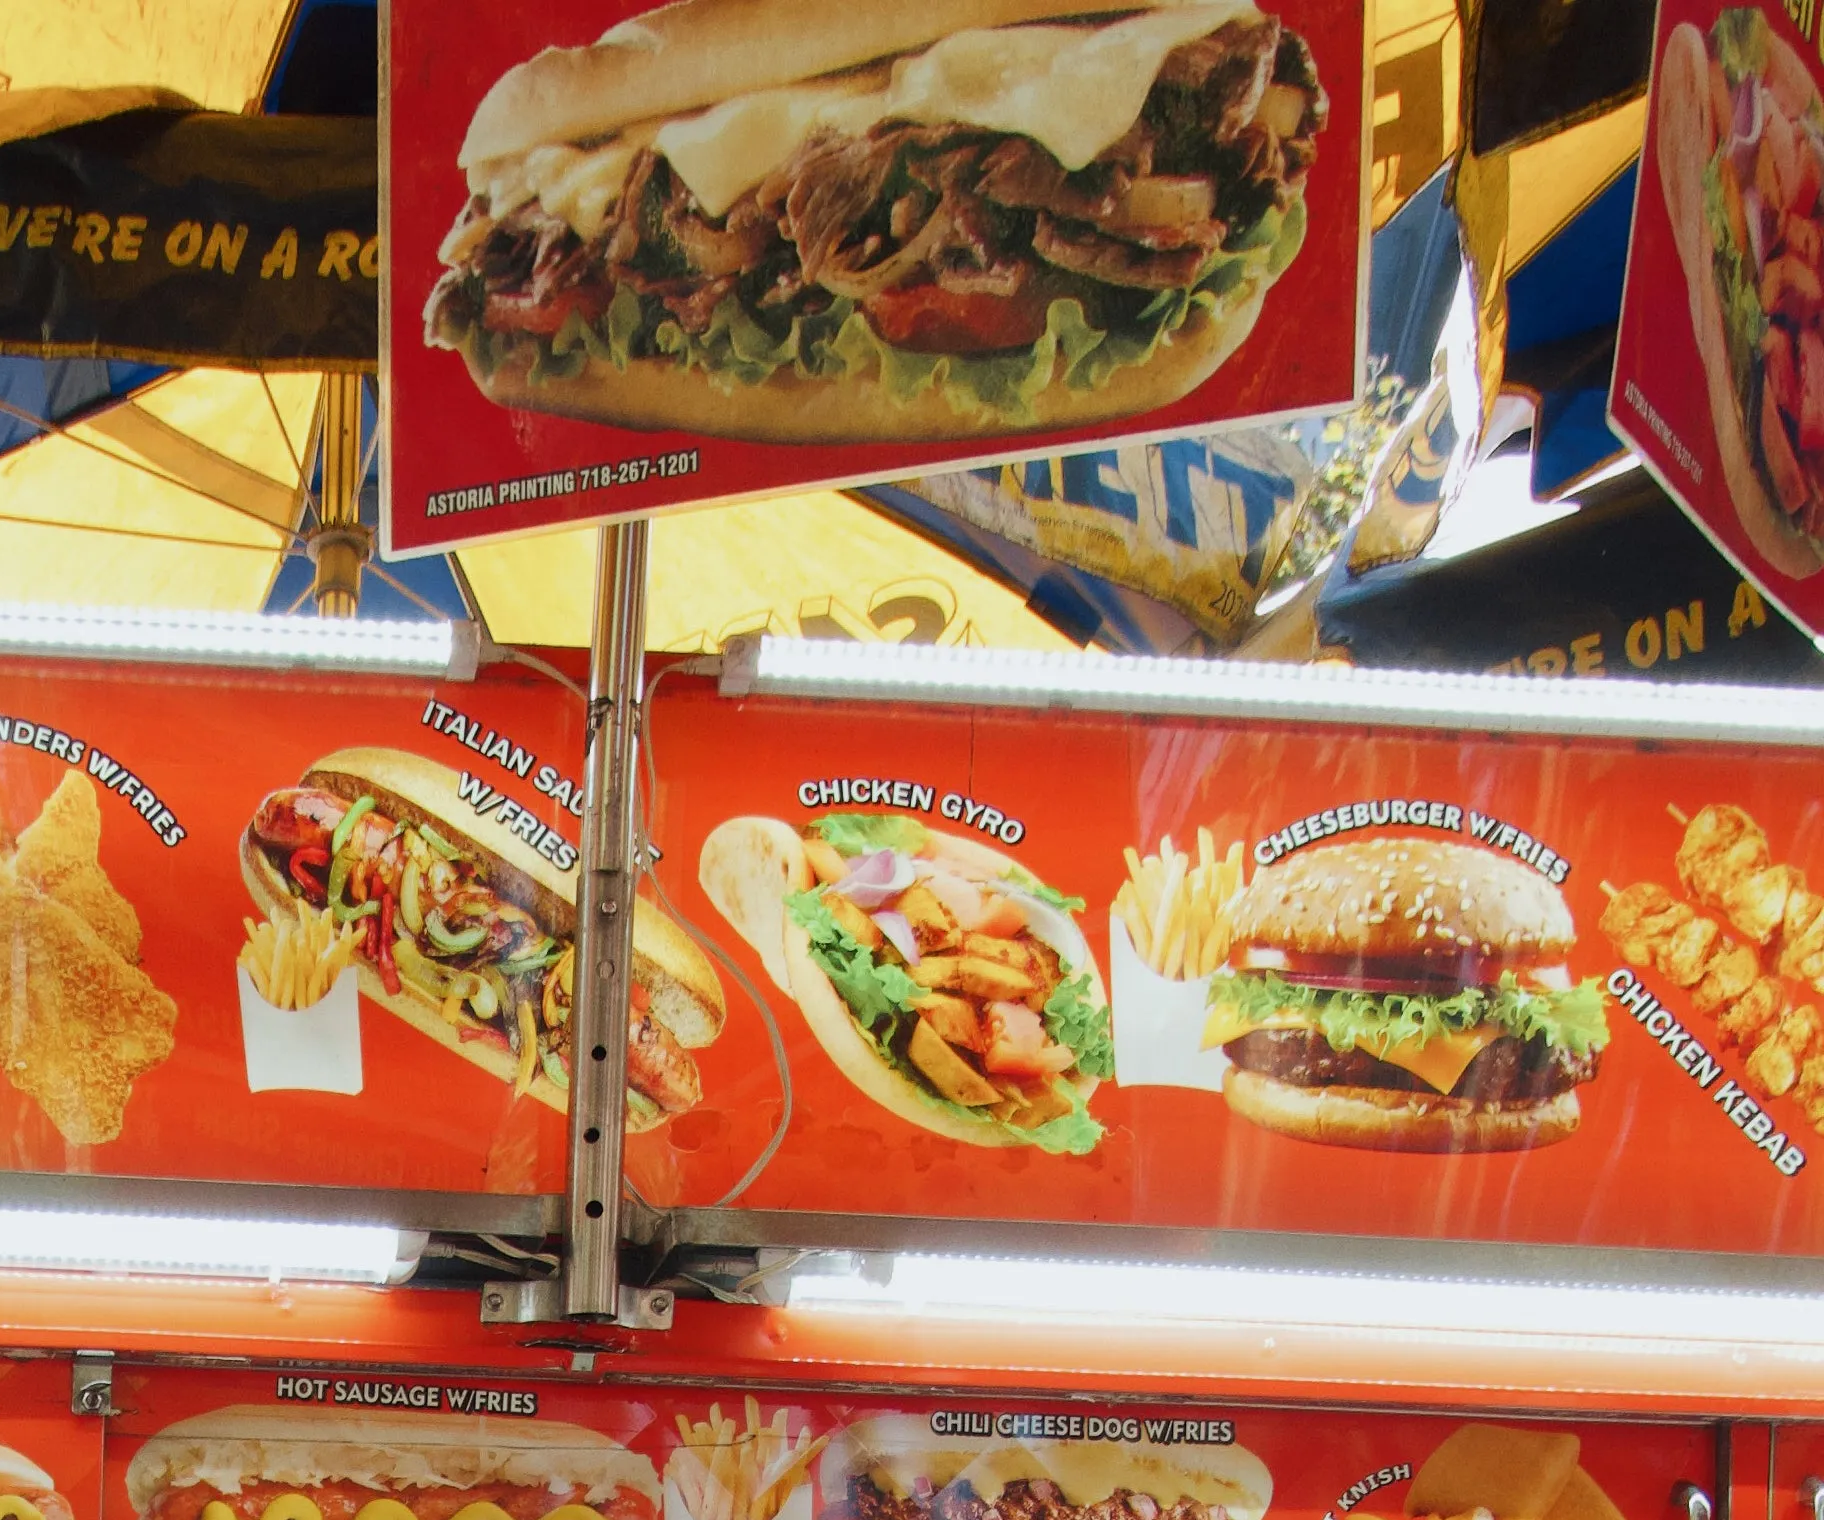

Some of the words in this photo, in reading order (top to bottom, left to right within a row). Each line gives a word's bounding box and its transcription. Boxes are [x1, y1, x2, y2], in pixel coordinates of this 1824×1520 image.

[164, 220, 249, 276] ON
[259, 227, 298, 280] A
[425, 485, 495, 519] ASTORIA
[497, 472, 576, 506] PRINTING
[579, 449, 700, 493] 718-267-1201
[1625, 601, 1706, 670] ON
[1727, 578, 1768, 639] A
[420, 698, 536, 780] ITALIAN
[85, 747, 189, 850] W/FRIES
[457, 769, 579, 872] W/FRIES
[796, 777, 935, 809] CHICKEN
[938, 792, 1028, 847] GYRO
[1252, 798, 1464, 868] CHEESEBURGER
[1468, 809, 1572, 887] W/FRIES
[1604, 966, 1723, 1091] CHICKEN
[1711, 1078, 1808, 1179] KEBAB
[276, 1376, 328, 1401] HOT
[333, 1381, 441, 1410] SAUSAGE
[445, 1387, 538, 1416] W/FRIES
[930, 1409, 992, 1437] CHILI
[995, 1414, 1086, 1441] CHEESE
[1087, 1417, 1142, 1442] DOG
[1144, 1417, 1235, 1445] W/FRIES
[1335, 1461, 1414, 1512] KNISH
